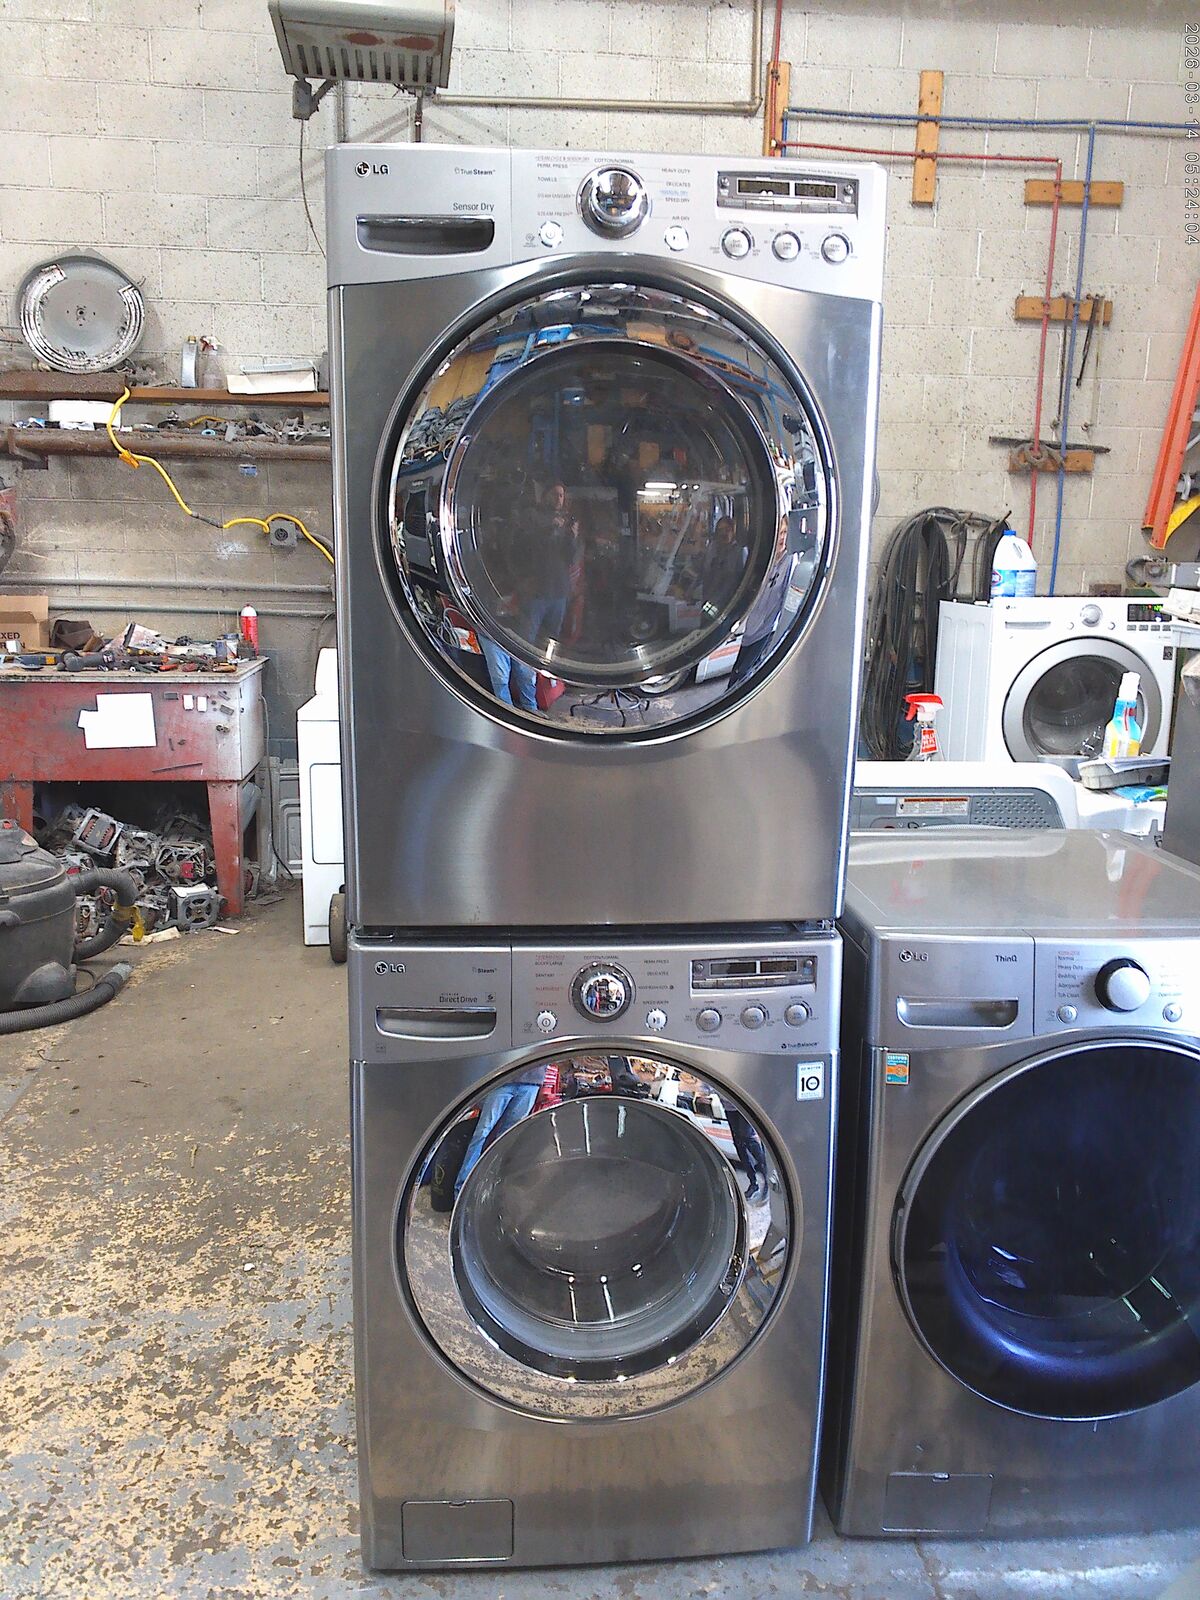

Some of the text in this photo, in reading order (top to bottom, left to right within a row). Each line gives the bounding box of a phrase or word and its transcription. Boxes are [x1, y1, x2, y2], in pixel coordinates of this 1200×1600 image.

[452, 202, 495, 212] Sensor Dry
[995, 954, 1018, 962] ThinQ
[801, 1076, 820, 1092] 10
